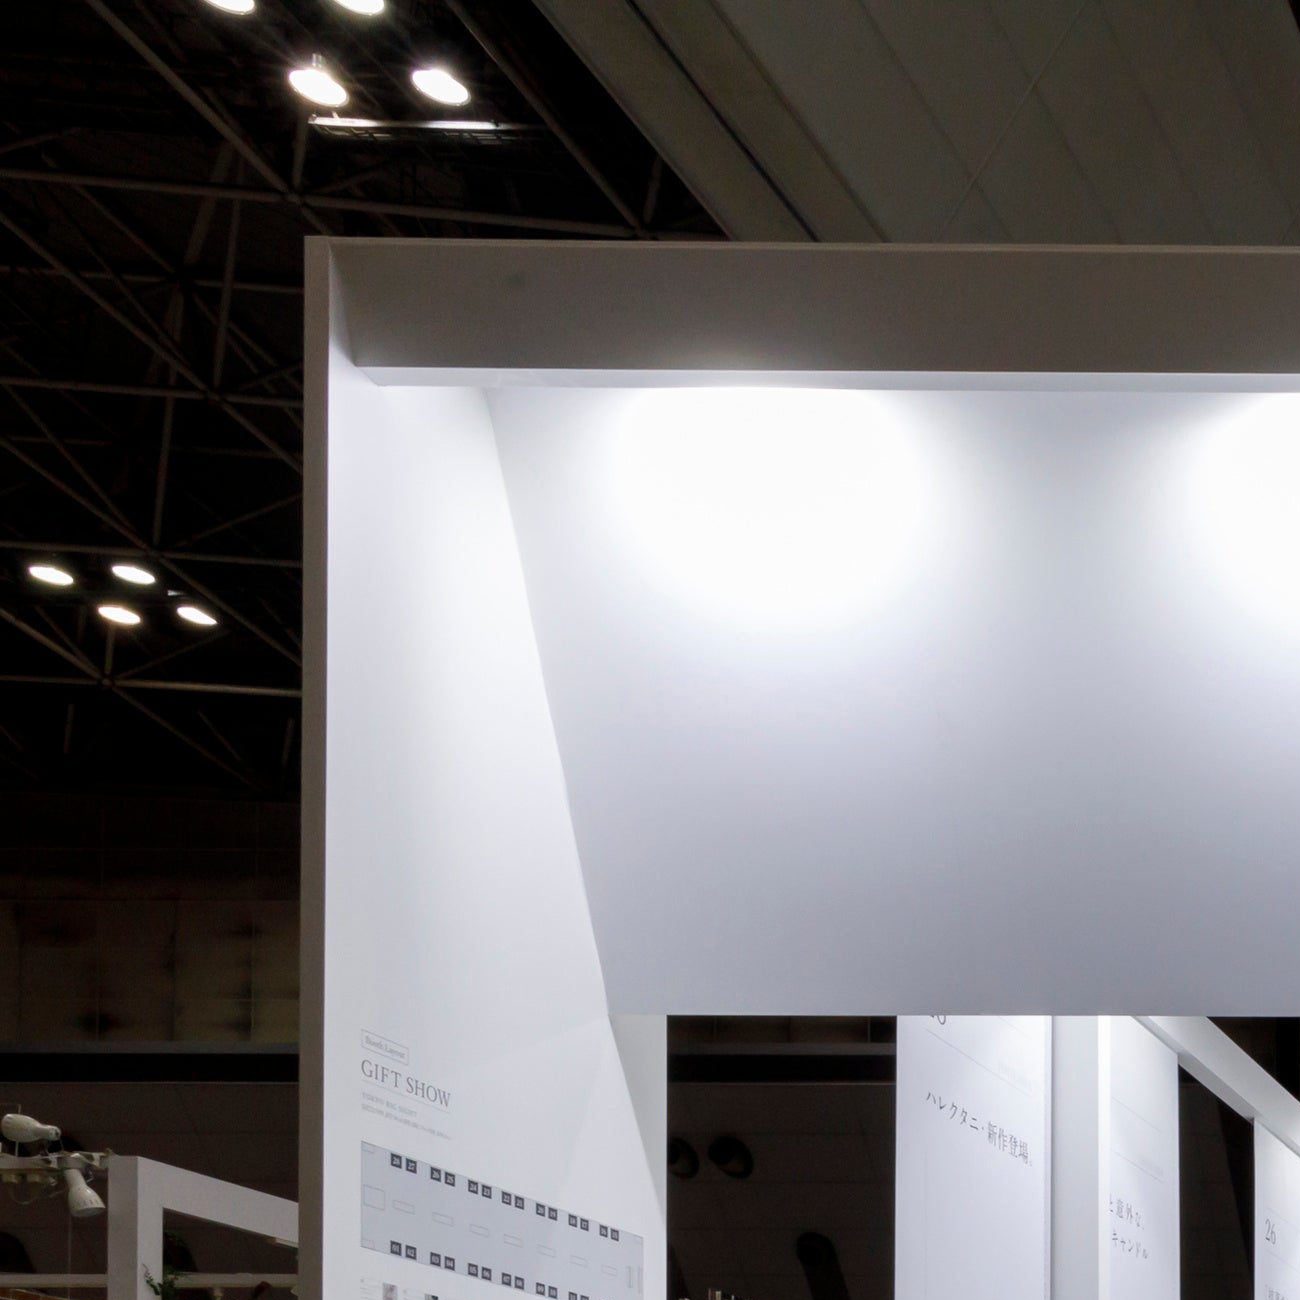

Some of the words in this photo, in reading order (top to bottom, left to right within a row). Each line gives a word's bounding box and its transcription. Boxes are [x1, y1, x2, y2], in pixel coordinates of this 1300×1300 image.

[361, 1059, 402, 1088] GIFT
[405, 1076, 452, 1107] SHOW
[1265, 1218, 1277, 1246] 26
